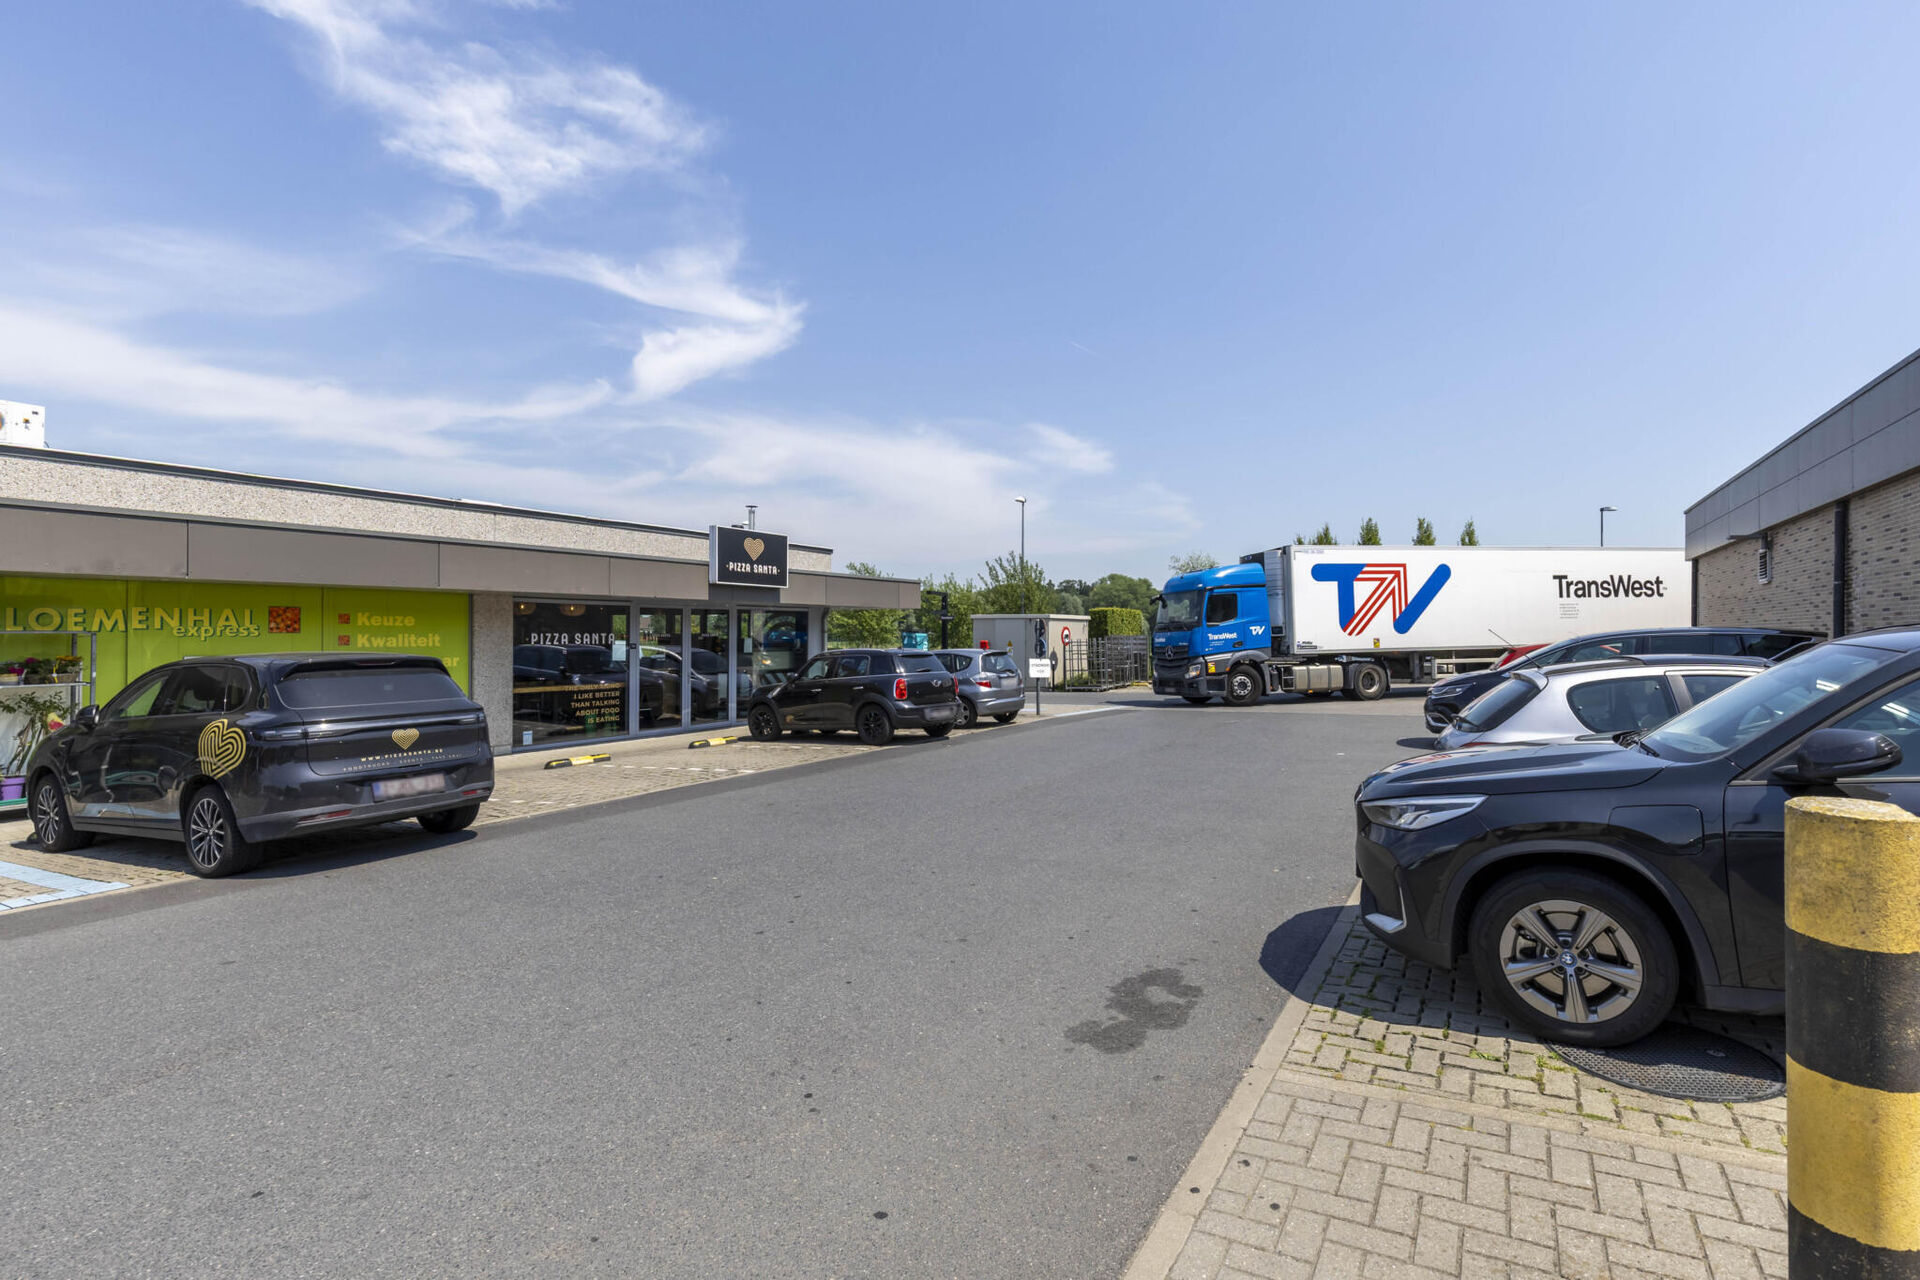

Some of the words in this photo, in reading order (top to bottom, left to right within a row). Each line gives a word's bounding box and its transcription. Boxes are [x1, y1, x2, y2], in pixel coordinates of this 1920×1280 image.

[729, 561, 751, 573] PIZZA
[753, 564, 777, 575] SANTA
[1552, 574, 1664, 598] TransWest
[356, 612, 415, 626] Keuze
[173, 624, 260, 641] express
[530, 632, 569, 645] PIZZA
[574, 632, 615, 645] SANTA
[1207, 632, 1238, 640] TransWest
[356, 633, 441, 648] Kwaliteit
[595, 690, 620, 698] BETTER
[575, 708, 599, 716] ABOUT
[601, 706, 620, 714] FOOD
